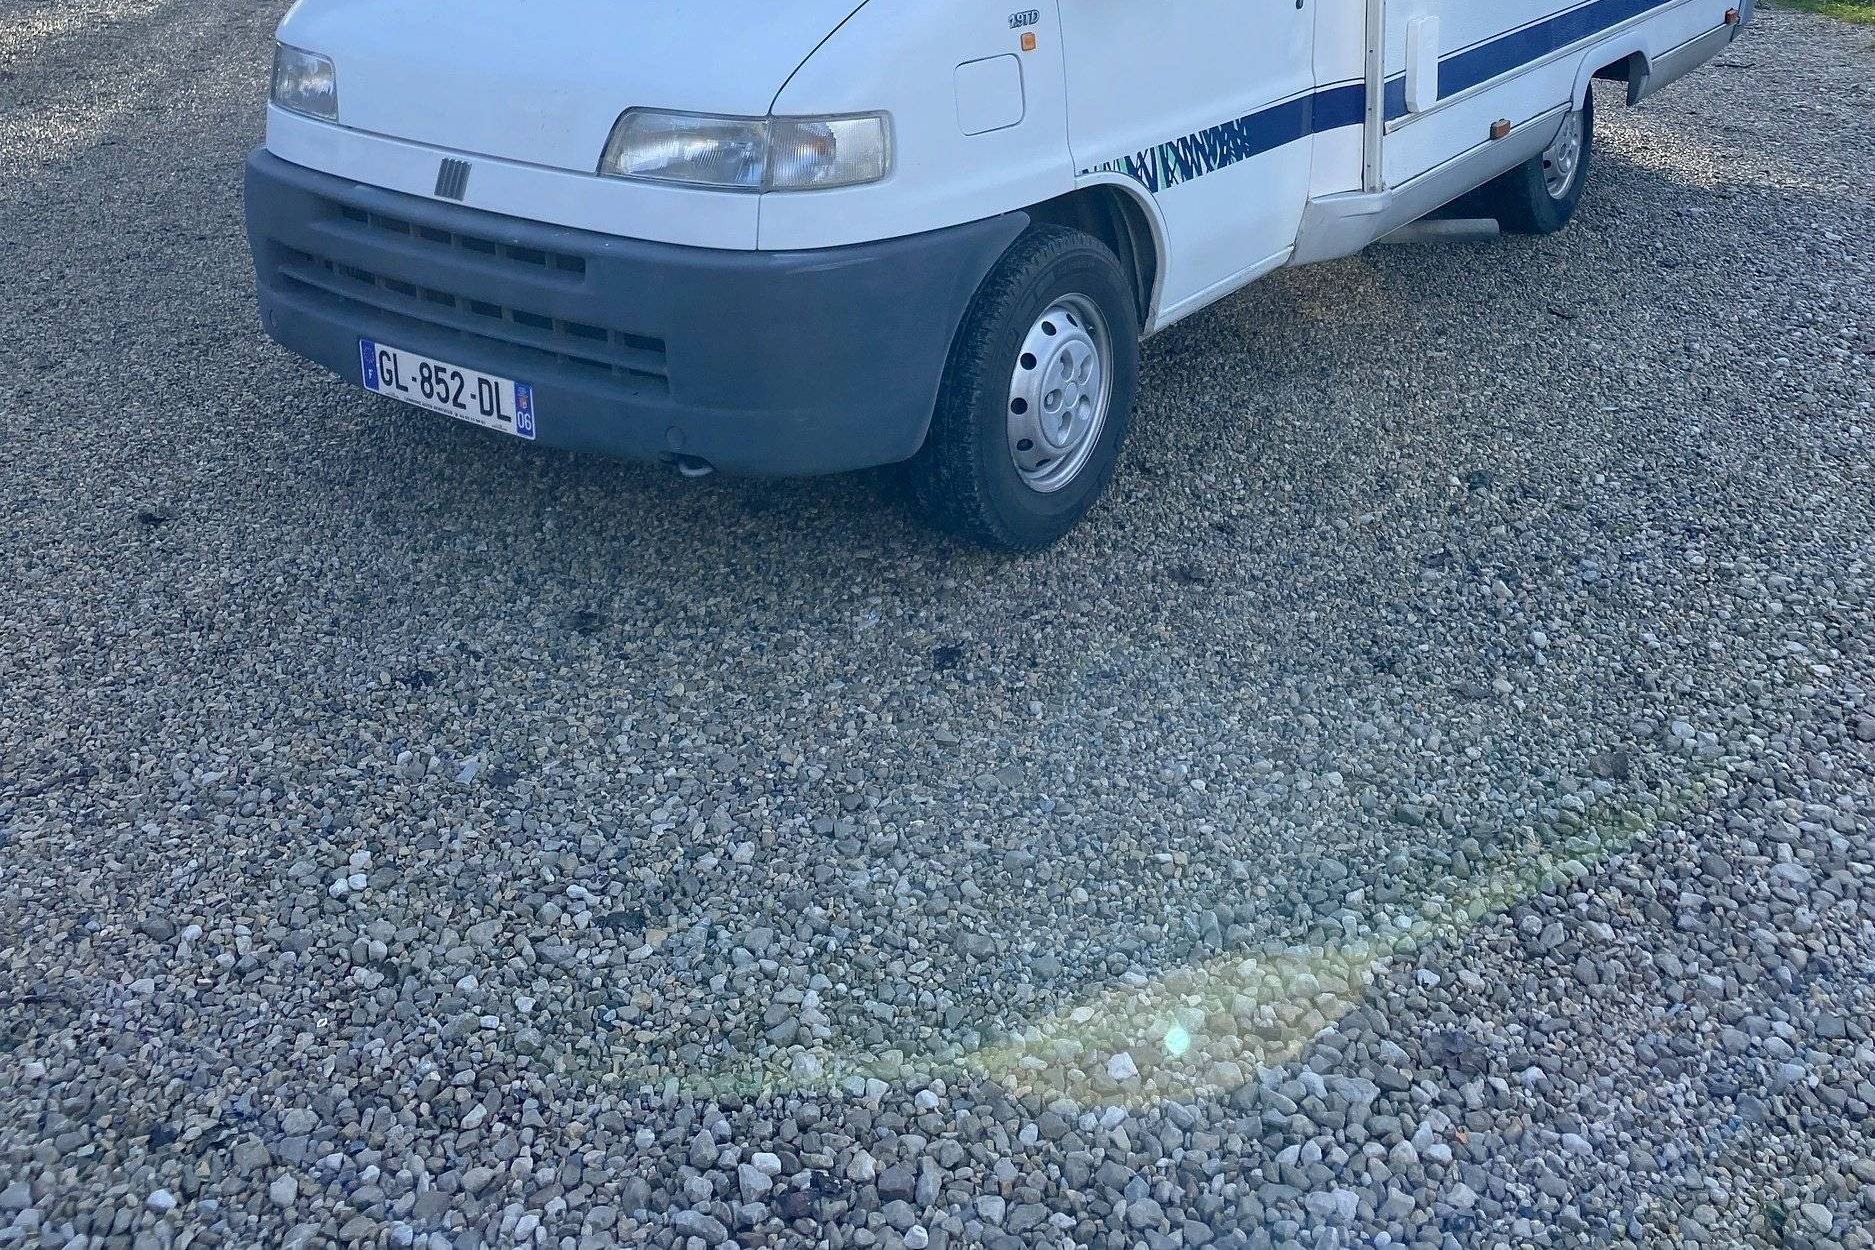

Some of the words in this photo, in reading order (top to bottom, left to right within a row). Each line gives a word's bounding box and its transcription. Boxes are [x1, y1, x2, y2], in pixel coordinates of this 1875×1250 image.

[368, 369, 374, 380] F
[379, 350, 512, 423] GL-852-DL
[517, 411, 532, 431] 06
